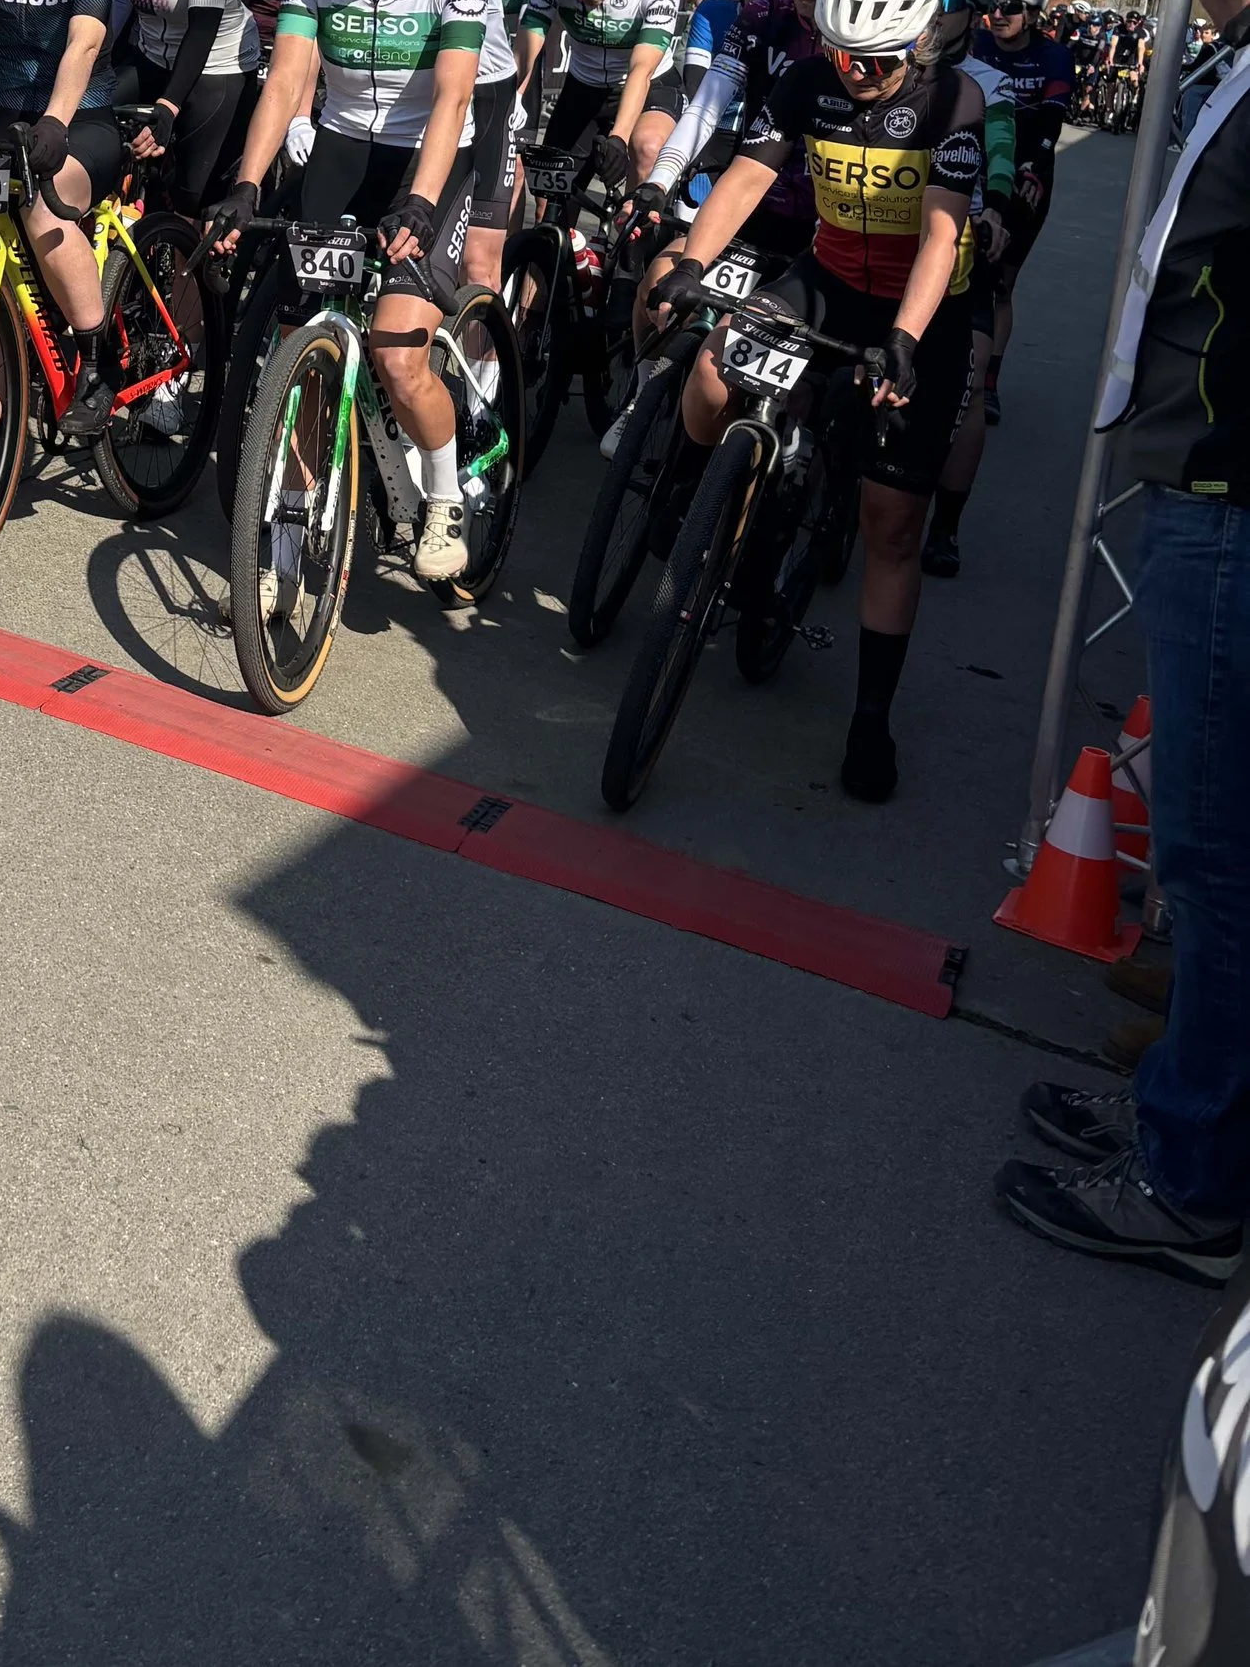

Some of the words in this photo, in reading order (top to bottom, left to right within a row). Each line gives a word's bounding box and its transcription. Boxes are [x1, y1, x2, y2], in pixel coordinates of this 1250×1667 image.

[331, 12, 419, 36] SERSO
[529, 169, 569, 191] 735
[812, 153, 921, 191] SERSO
[822, 196, 911, 221] cropland
[447, 195, 472, 265] SERSO
[300, 248, 356, 280] 840
[741, 322, 800, 352] SPECIALIZED
[729, 338, 794, 384] 814
